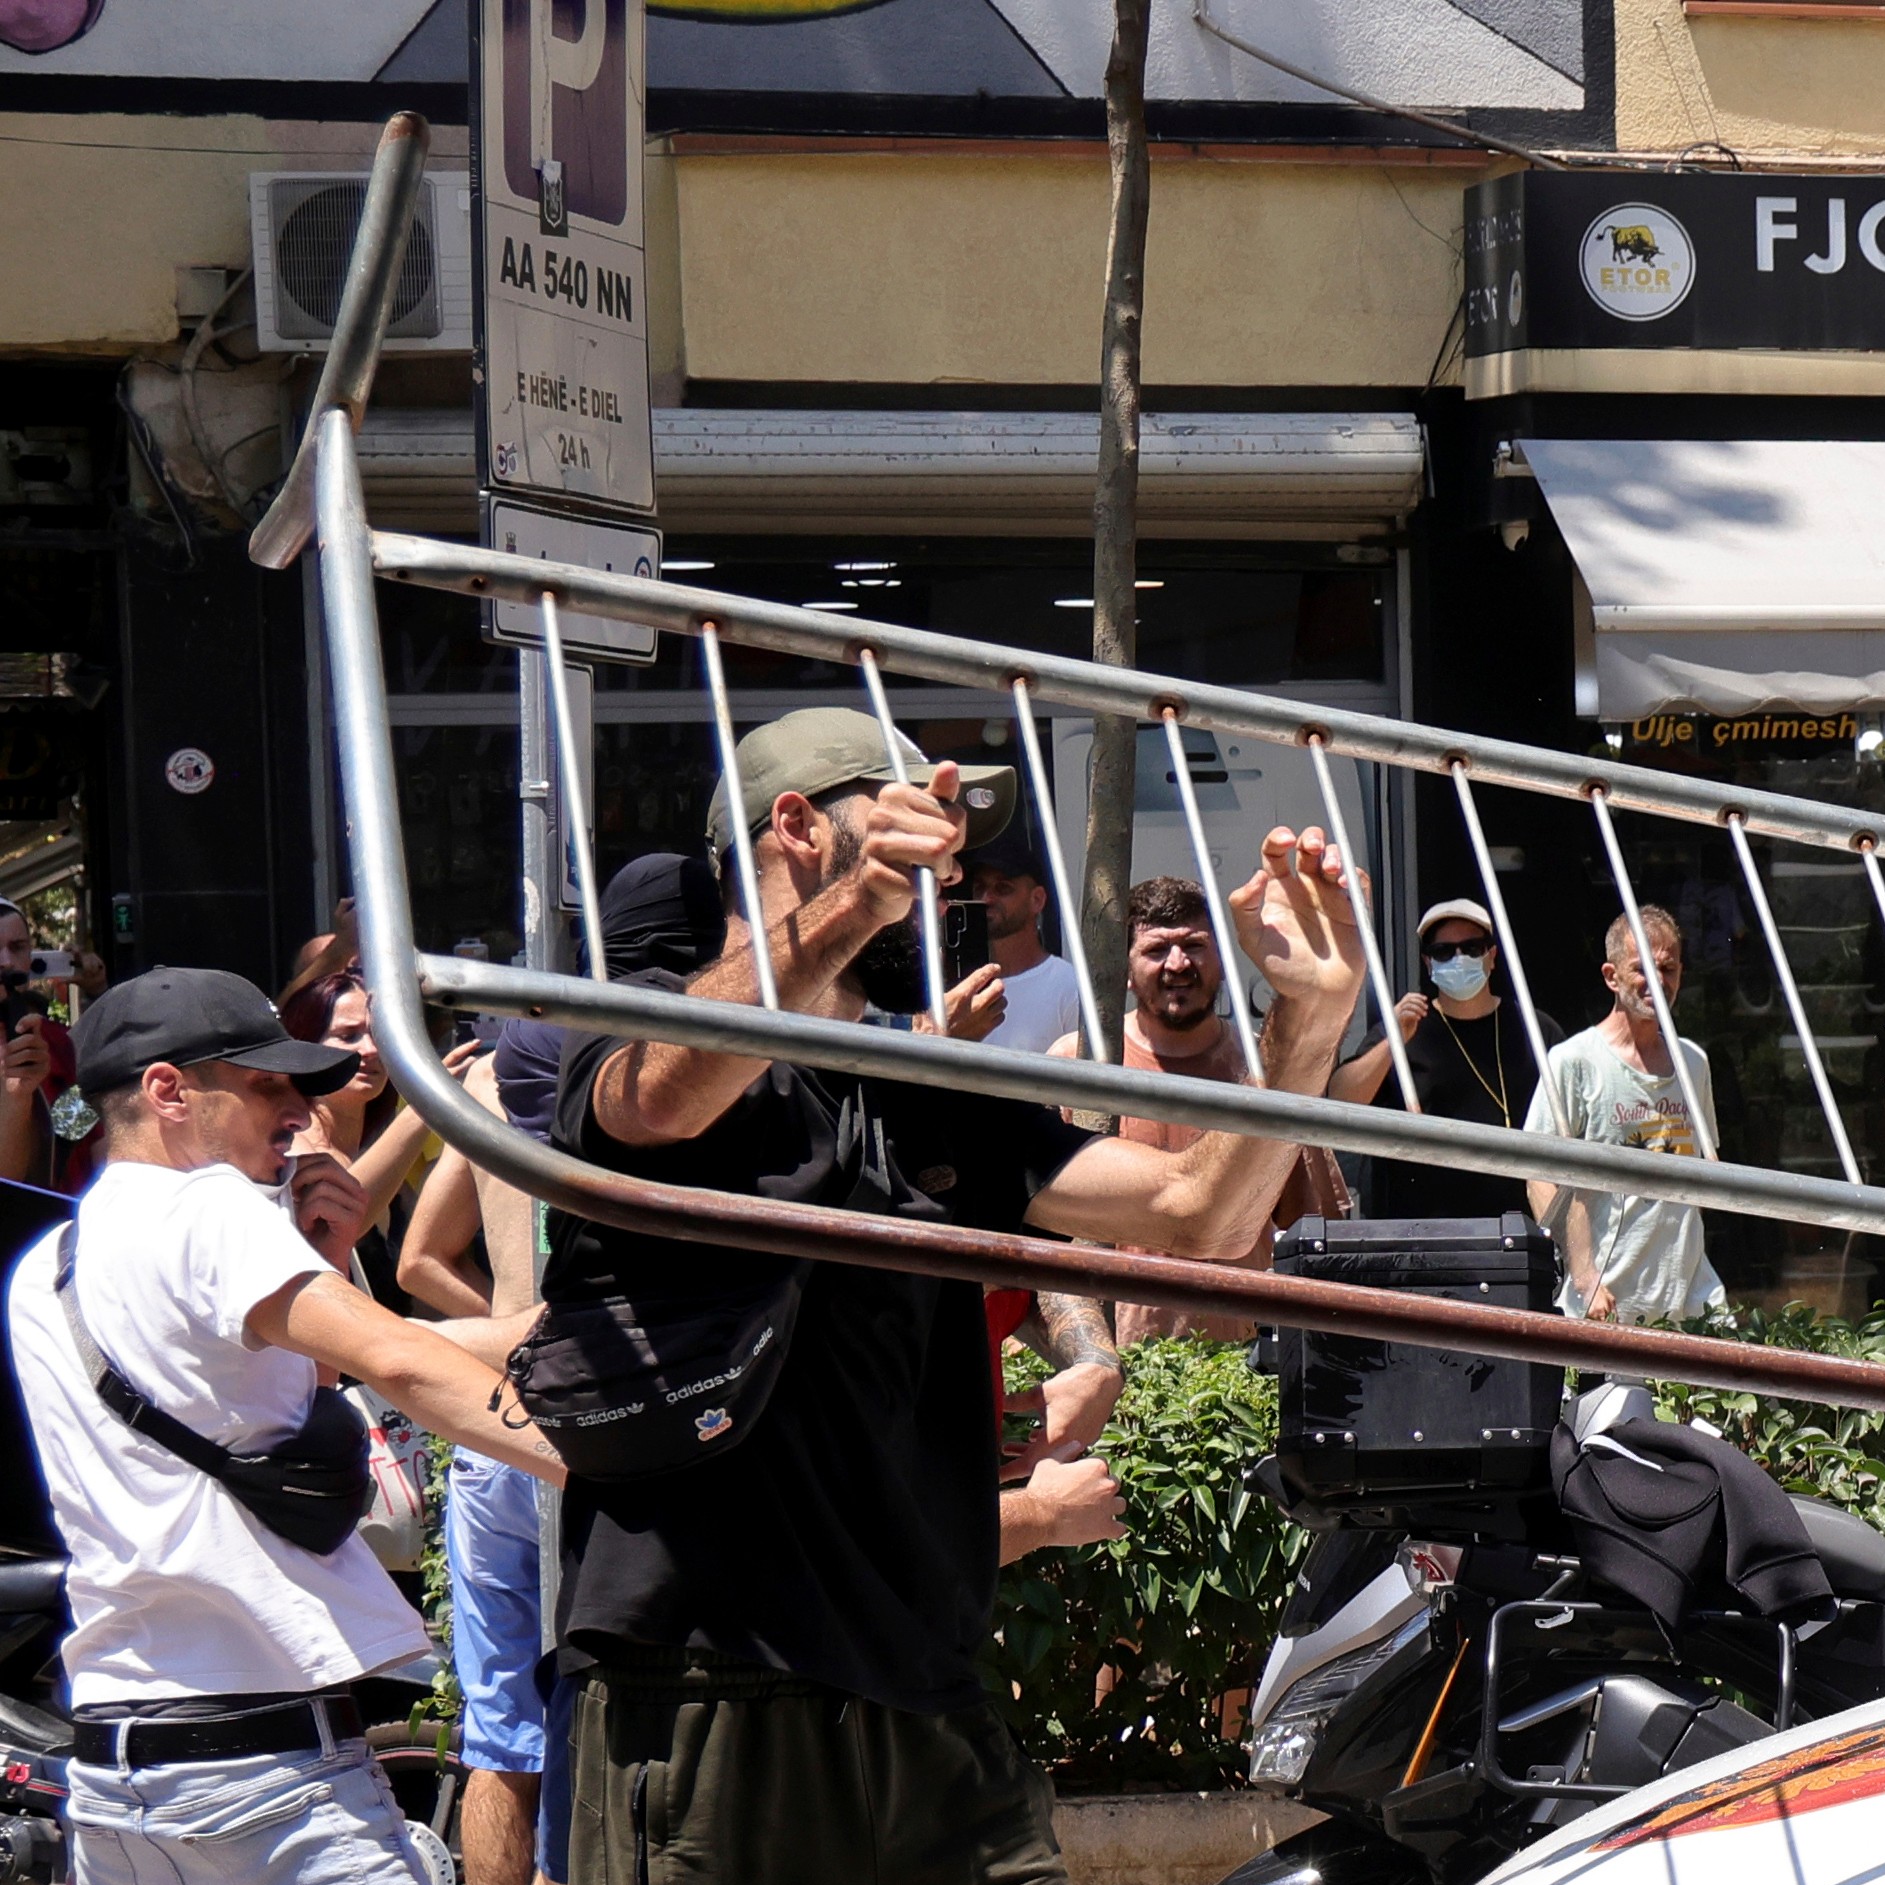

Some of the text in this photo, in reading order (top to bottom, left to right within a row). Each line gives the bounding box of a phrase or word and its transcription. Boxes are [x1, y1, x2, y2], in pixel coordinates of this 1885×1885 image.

[501, 236, 633, 322] AA 540 NN
[1600, 268, 1671, 285] ETOR
[518, 372, 526, 402] E
[530, 371, 568, 412] HËNË
[579, 386, 588, 416] E
[592, 389, 622, 424] DIEL
[558, 433, 590, 469] 24 h
[1632, 712, 1858, 746] Ulje çmimesh
[666, 1376, 724, 1405] adidas
[576, 1407, 628, 1427] adidas
